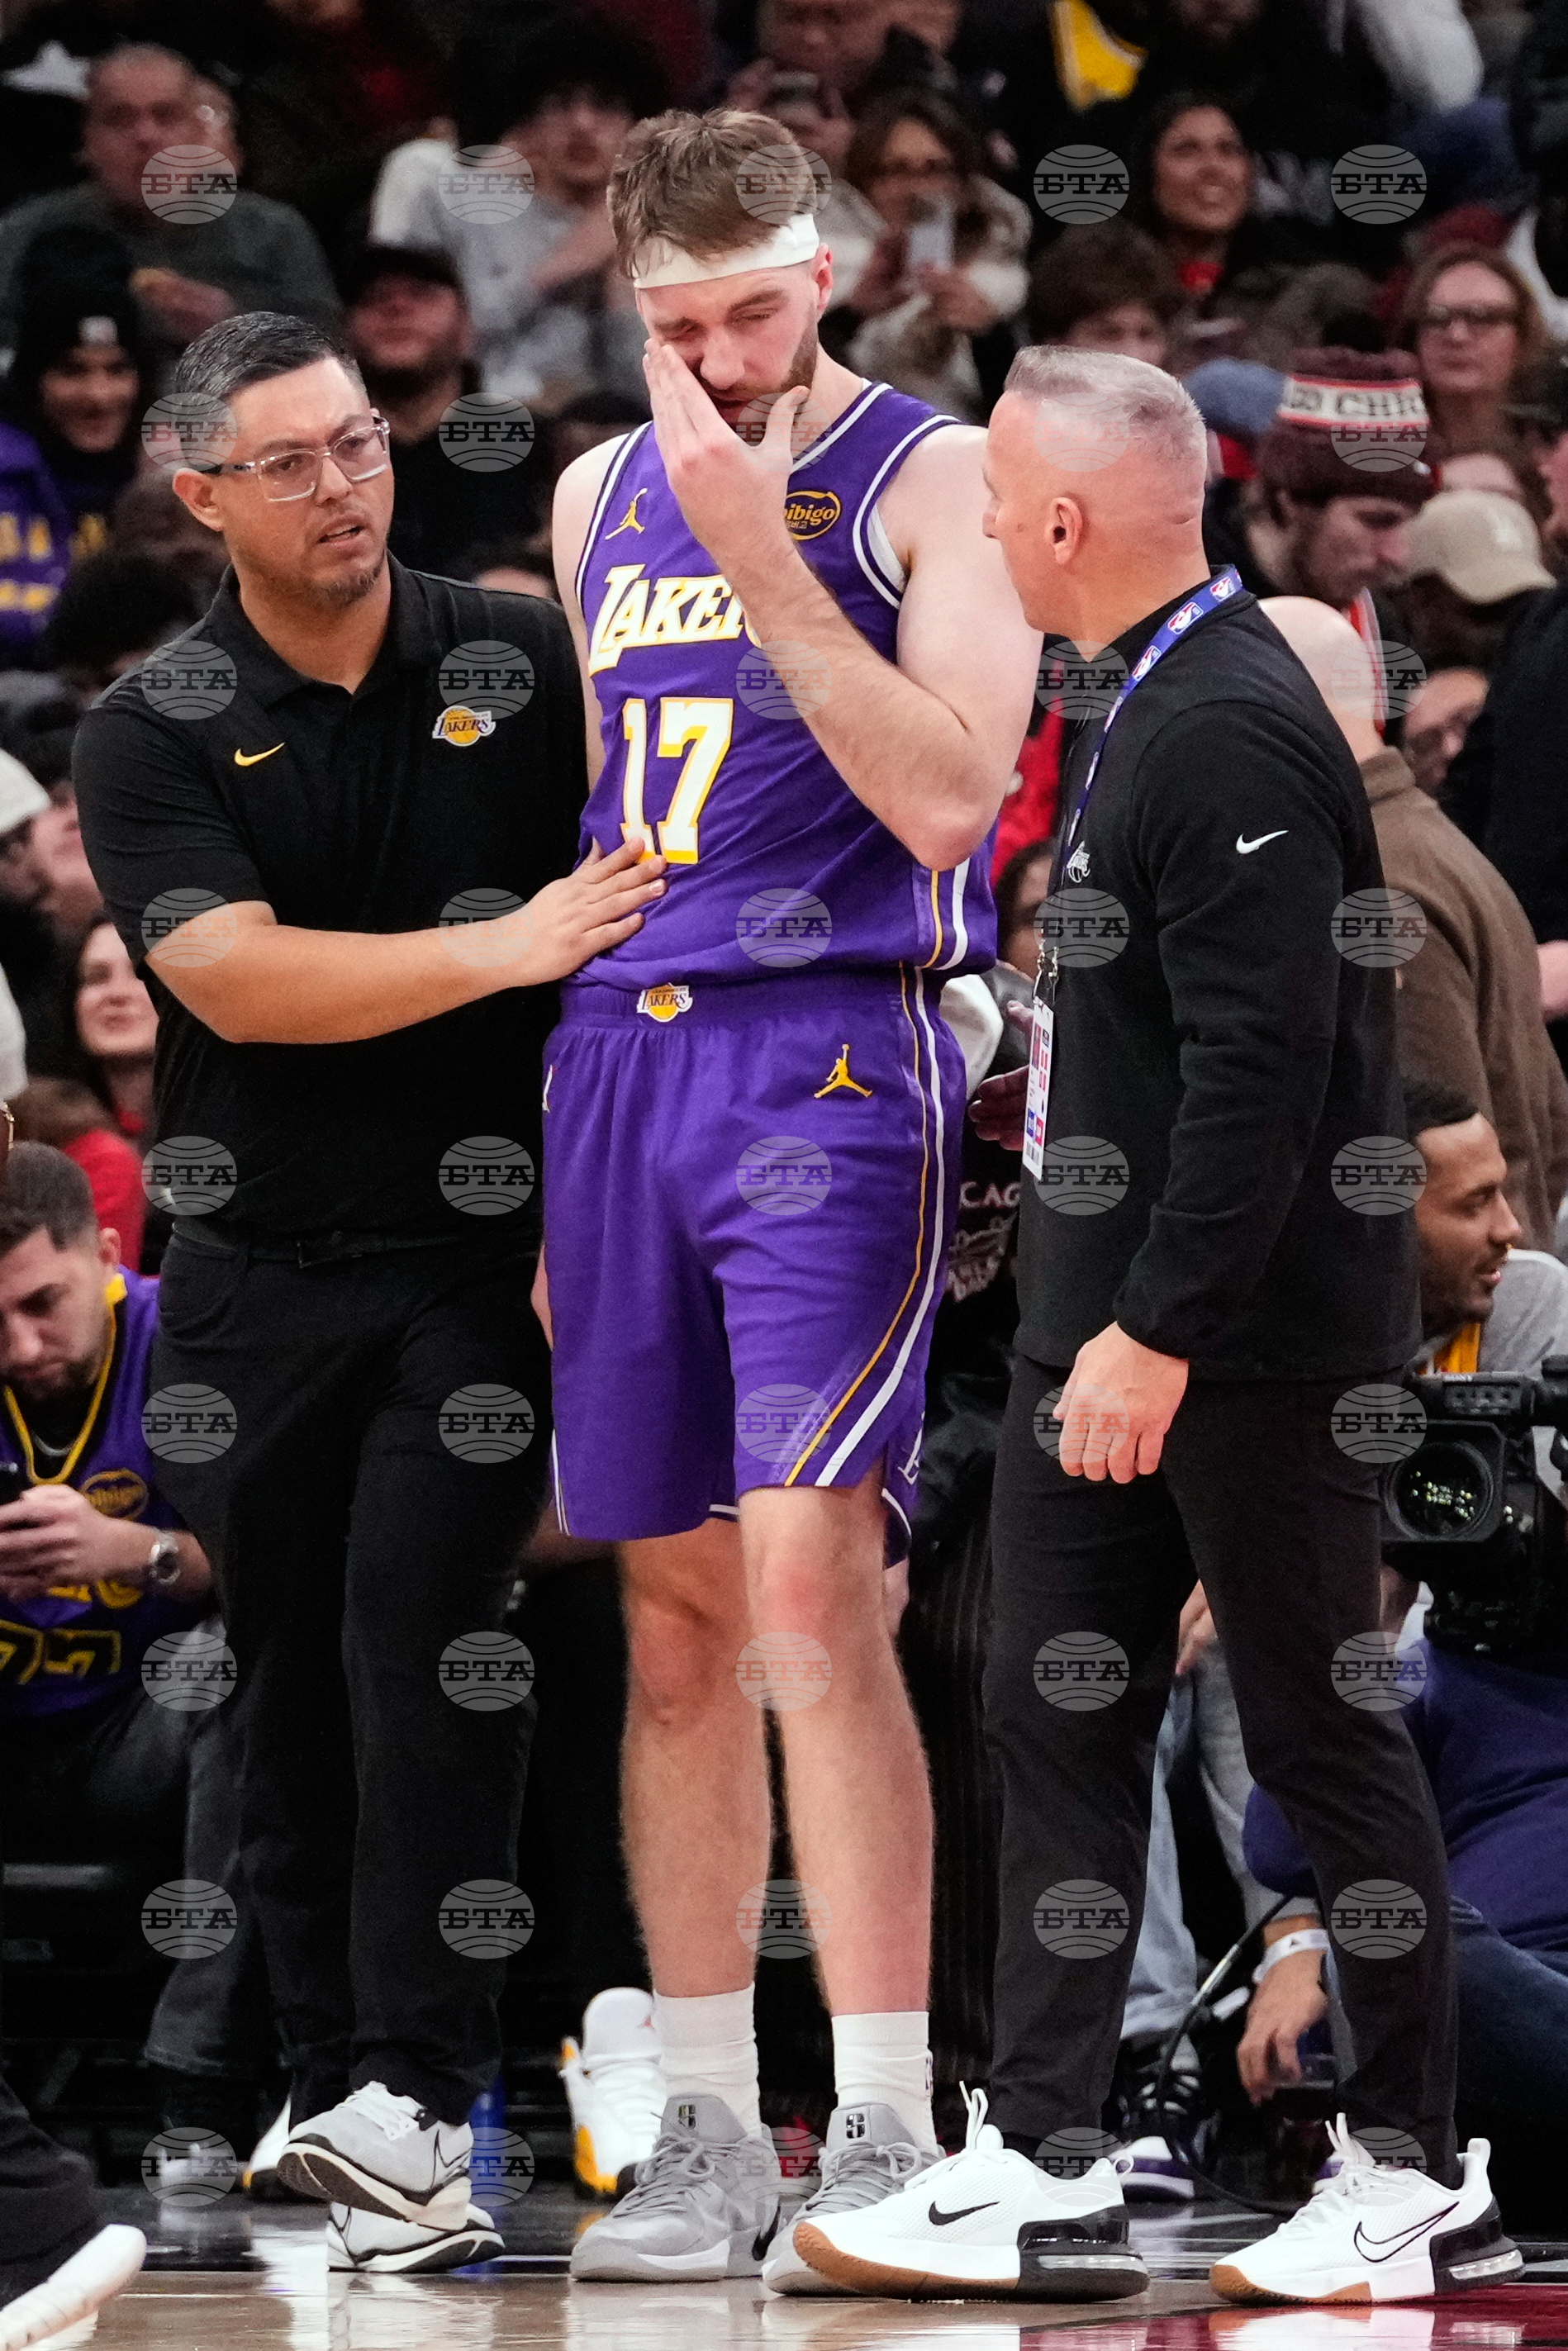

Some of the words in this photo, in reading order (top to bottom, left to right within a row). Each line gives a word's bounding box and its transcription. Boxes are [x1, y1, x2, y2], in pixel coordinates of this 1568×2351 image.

[435, 715, 492, 736] LAKERS
[620, 696, 734, 865] 17
[640, 990, 691, 1010] LAKERS
